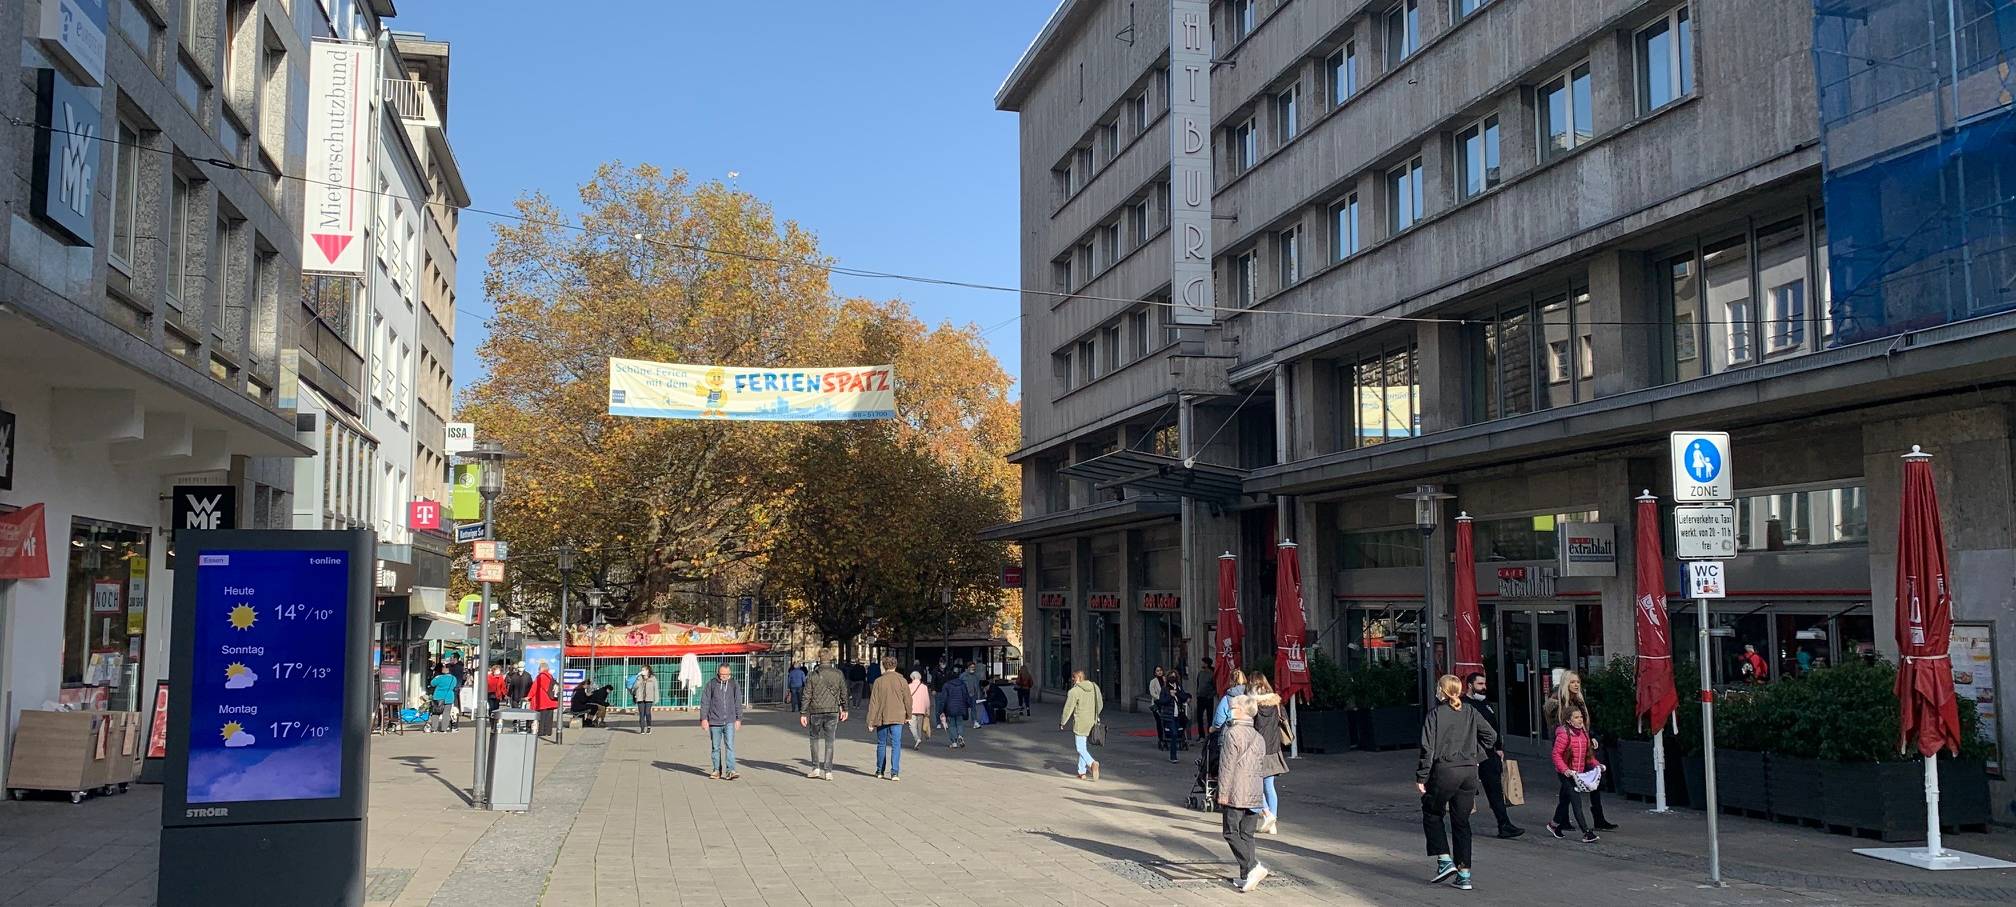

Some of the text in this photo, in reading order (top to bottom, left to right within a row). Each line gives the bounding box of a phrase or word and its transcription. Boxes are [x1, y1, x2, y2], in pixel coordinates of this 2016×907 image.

[320, 50, 347, 228] Mieterschutzbund
[60, 101, 93, 217] WMF
[656, 367, 687, 378] Ferien
[666, 379, 688, 389] dem
[448, 427, 467, 439] ISSA
[1691, 485, 1719, 497] ZONE
[185, 494, 222, 530] WMF
[1679, 514, 1714, 525] Lieferverkehr
[1721, 514, 1732, 524] Taxi
[1699, 528, 1709, 537] von
[1569, 538, 1613, 555] extrablatt
[1701, 541, 1712, 551] frei
[203, 554, 225, 565] Essen
[309, 556, 342, 566] t-online
[1695, 565, 1719, 577] WC
[224, 586, 255, 596] Heute
[95, 591, 119, 608] NOCH
[221, 645, 264, 656] Sonntag
[218, 704, 258, 716] Montag
[185, 807, 229, 818] STRÖER
